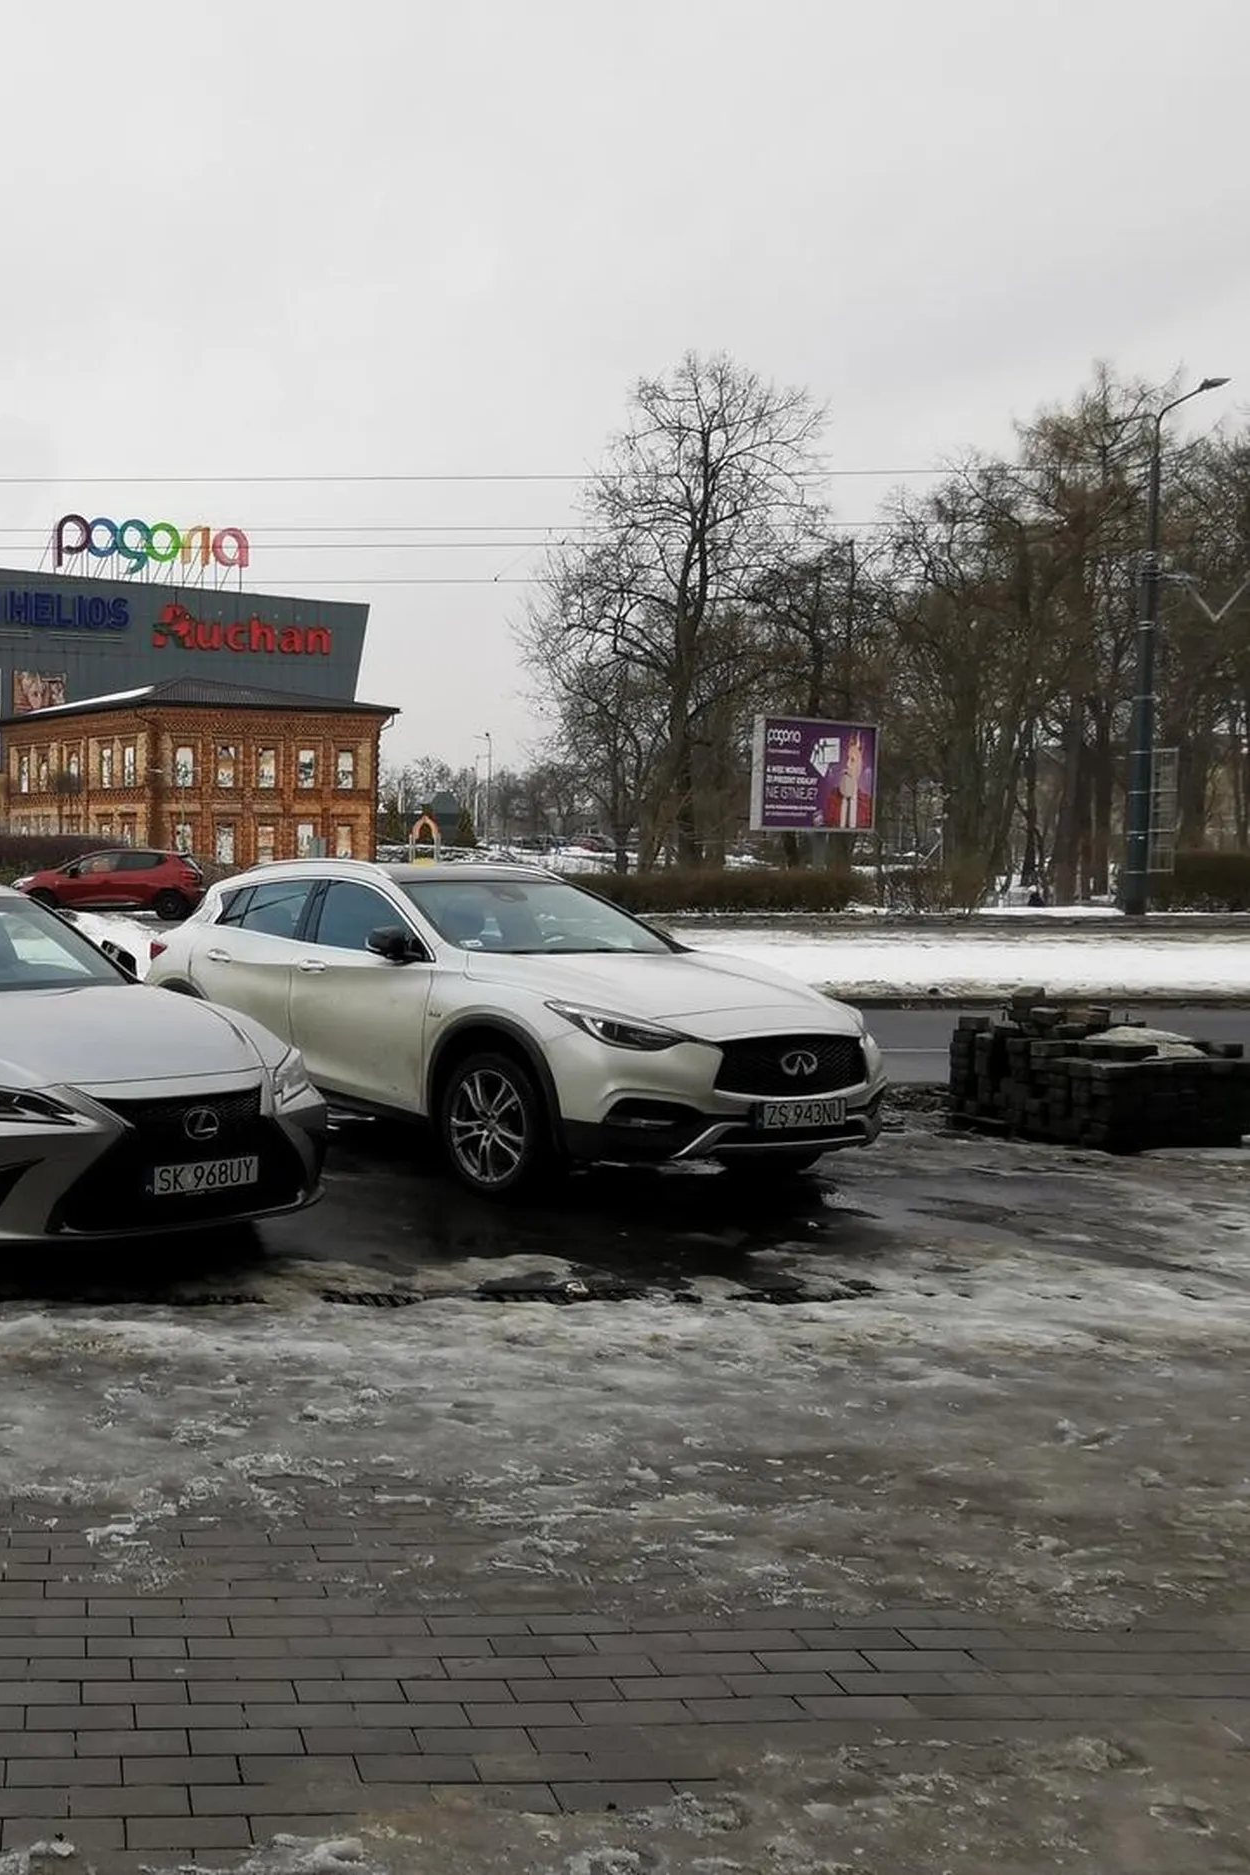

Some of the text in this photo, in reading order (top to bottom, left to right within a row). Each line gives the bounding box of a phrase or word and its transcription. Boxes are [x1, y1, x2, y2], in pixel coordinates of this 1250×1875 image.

[55, 513, 249, 575] pogoria
[6, 590, 130, 630] HELIOS
[152, 603, 332, 655] Auchan
[766, 1104, 789, 1126] ZS
[159, 1159, 253, 1191] SK 968UY
